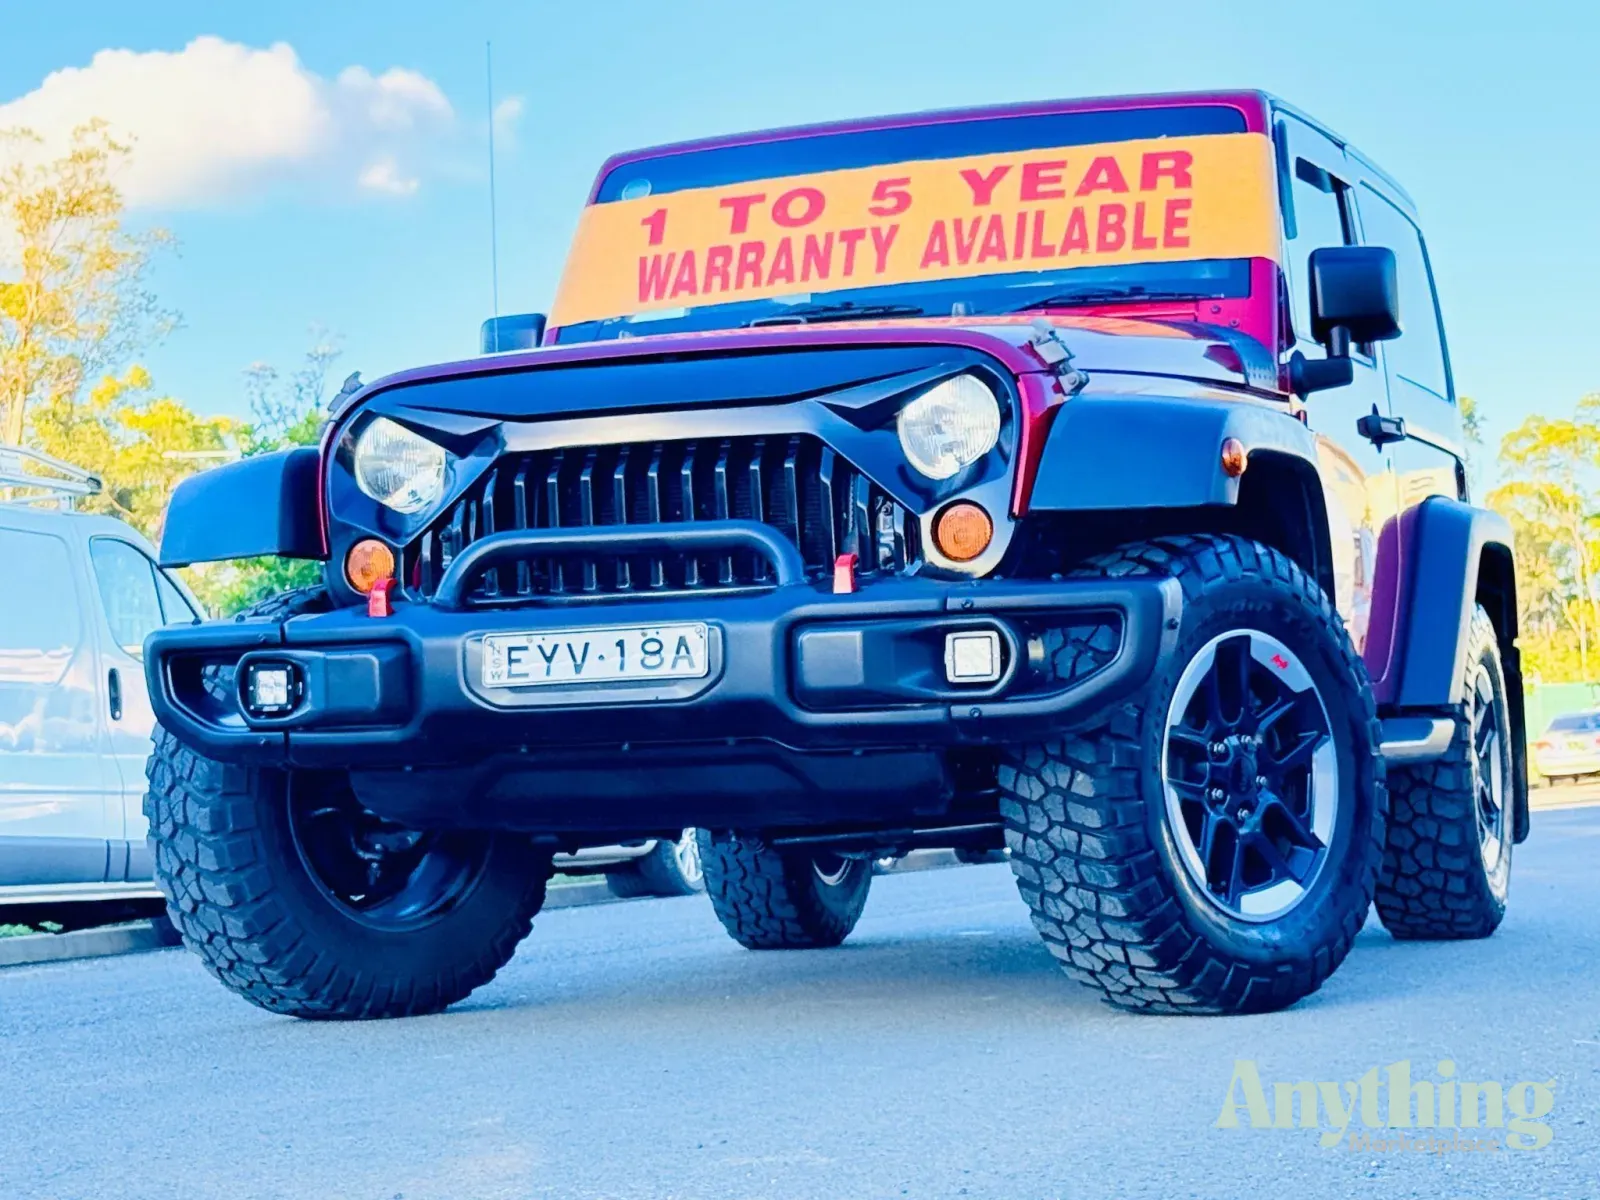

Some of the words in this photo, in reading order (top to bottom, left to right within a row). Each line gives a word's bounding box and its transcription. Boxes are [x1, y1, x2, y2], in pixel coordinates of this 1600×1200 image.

[641, 208, 668, 246] 1
[719, 187, 826, 234] TO
[868, 177, 912, 217] 5
[959, 150, 1194, 207] YEAR
[638, 224, 900, 304] WARRANTY
[920, 197, 1192, 269] AVAILABLE
